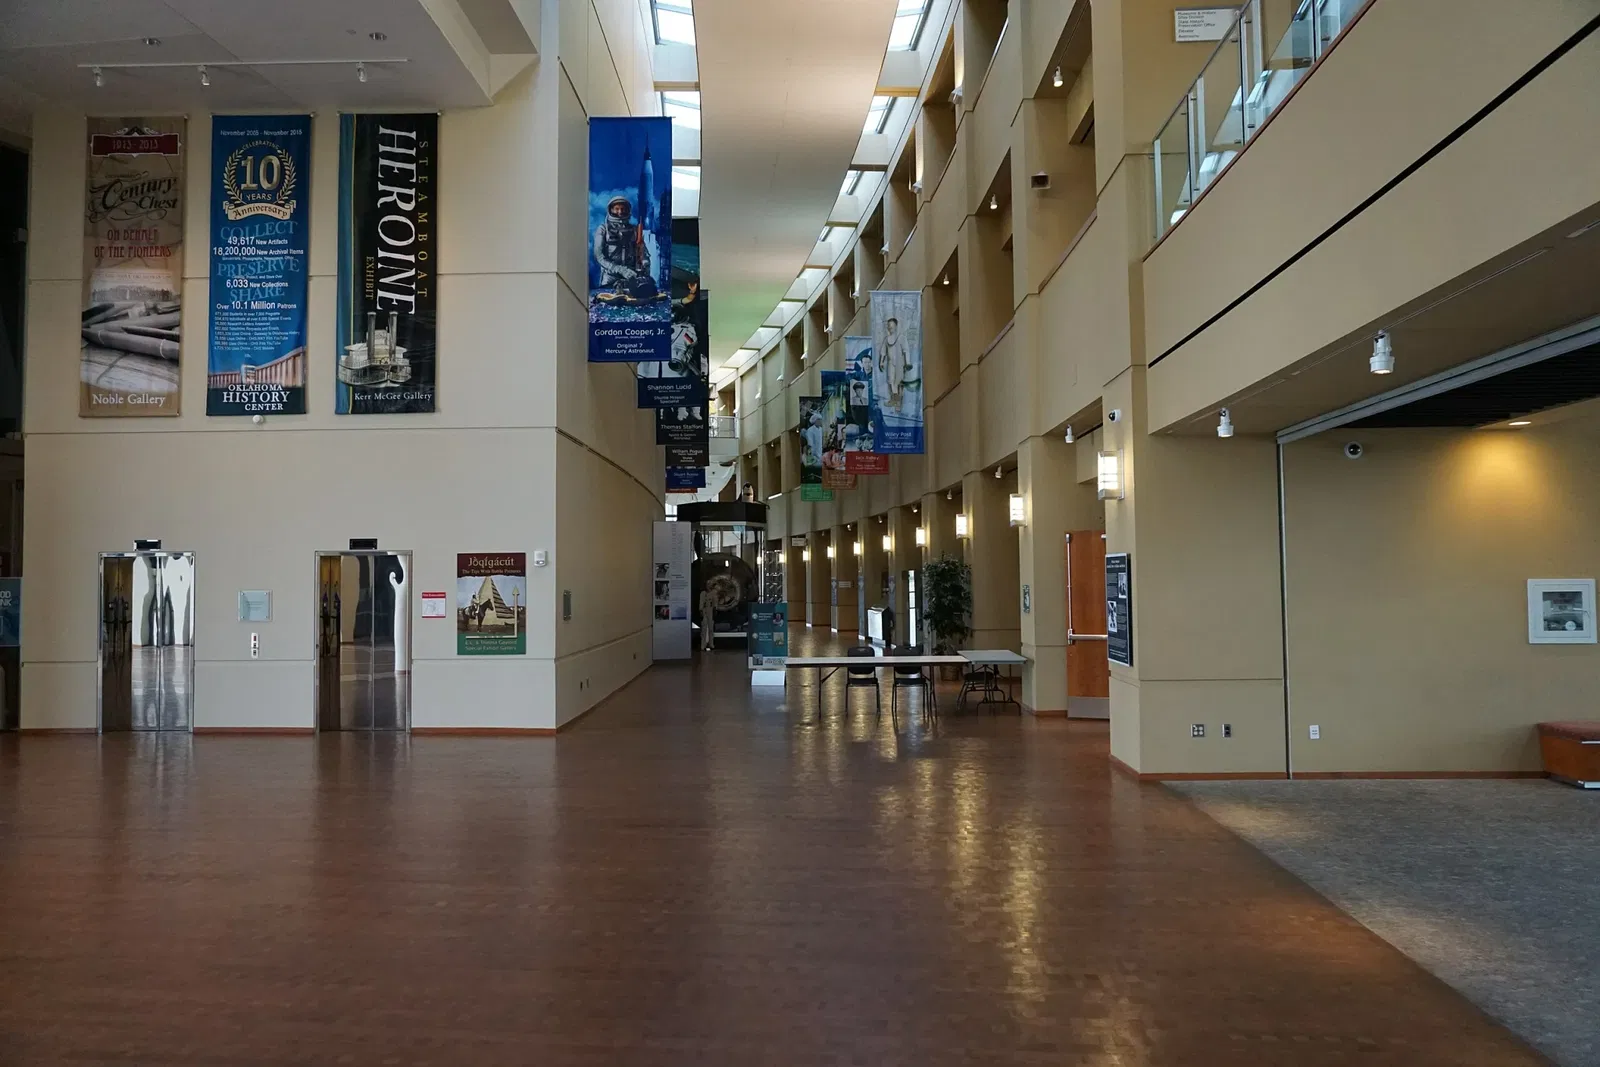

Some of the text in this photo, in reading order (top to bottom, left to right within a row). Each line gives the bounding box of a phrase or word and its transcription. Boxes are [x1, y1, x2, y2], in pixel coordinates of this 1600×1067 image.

[242, 140, 279, 150] CELEBRATING
[241, 155, 281, 190] 10
[97, 178, 178, 210] Century
[139, 196, 178, 210] Chest
[232, 205, 288, 219] Anniversary
[376, 124, 416, 314] HEROINE
[417, 140, 428, 298] STEAMBOAT
[220, 220, 298, 240] COLLECT
[228, 236, 254, 246] 49,617
[94, 246, 105, 258] OF
[109, 246, 124, 258] THE
[213, 247, 256, 256] 18,200,000
[217, 258, 300, 277] PRESERVE
[226, 279, 248, 288] 6,033
[365, 256, 374, 300] EXHIBIT
[230, 286, 285, 302] SHARE
[232, 301, 248, 309] 10.1
[625, 328, 654, 337] Cooper,
[92, 394, 166, 407] Noble Gallery
[222, 392, 290, 403] HISTORY
[374, 392, 400, 400] McGee
[403, 392, 432, 401] Gallery
